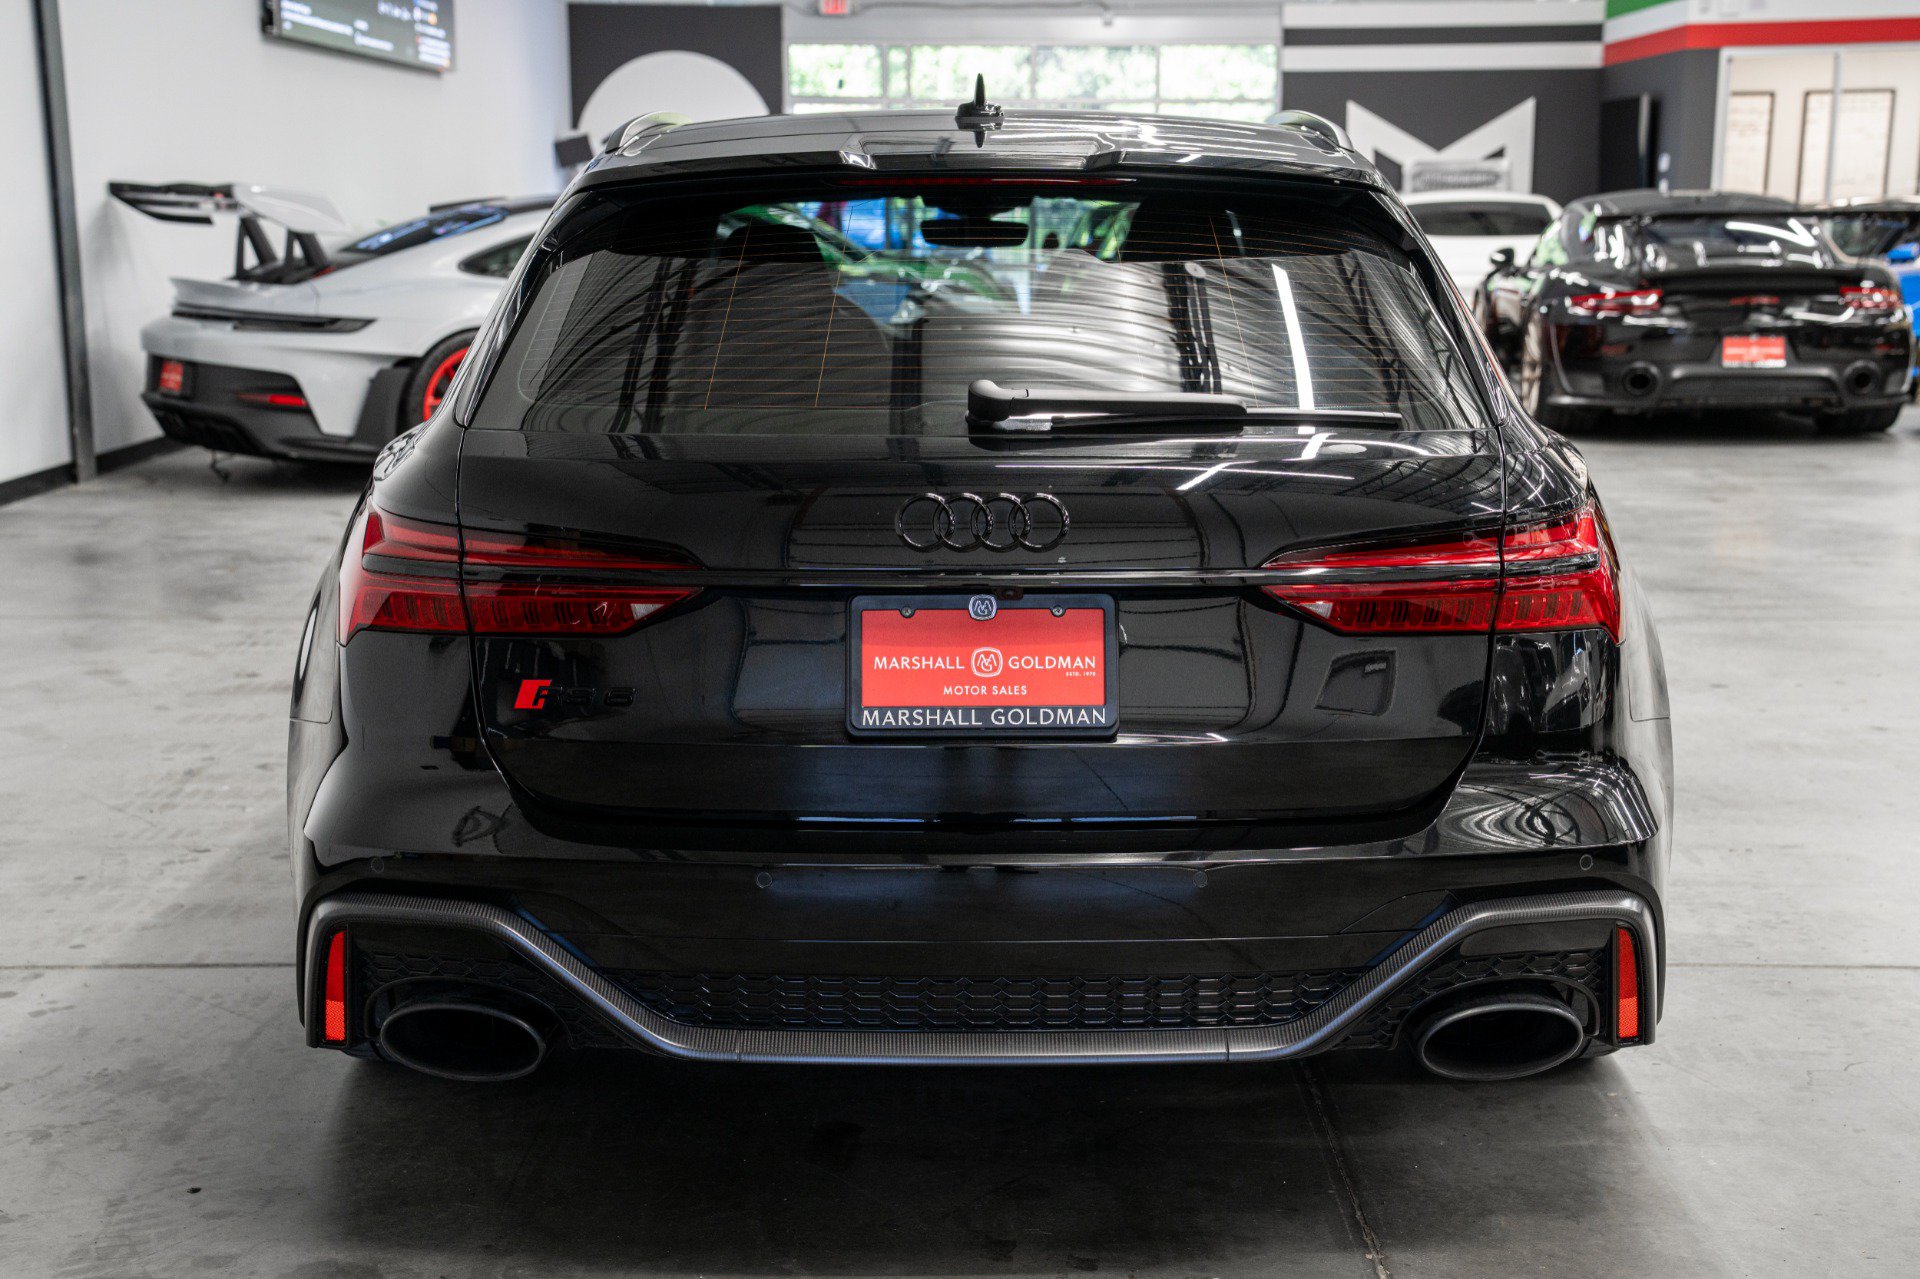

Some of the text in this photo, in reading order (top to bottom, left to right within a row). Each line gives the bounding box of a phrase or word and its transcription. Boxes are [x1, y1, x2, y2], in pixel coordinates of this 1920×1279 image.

[873, 655, 965, 670] MARSHALL
[1008, 655, 1096, 670] GOLDMAN
[943, 685, 1028, 696] MOTOR SALES
[862, 708, 1106, 726] MARSHALL GOLDMAN
